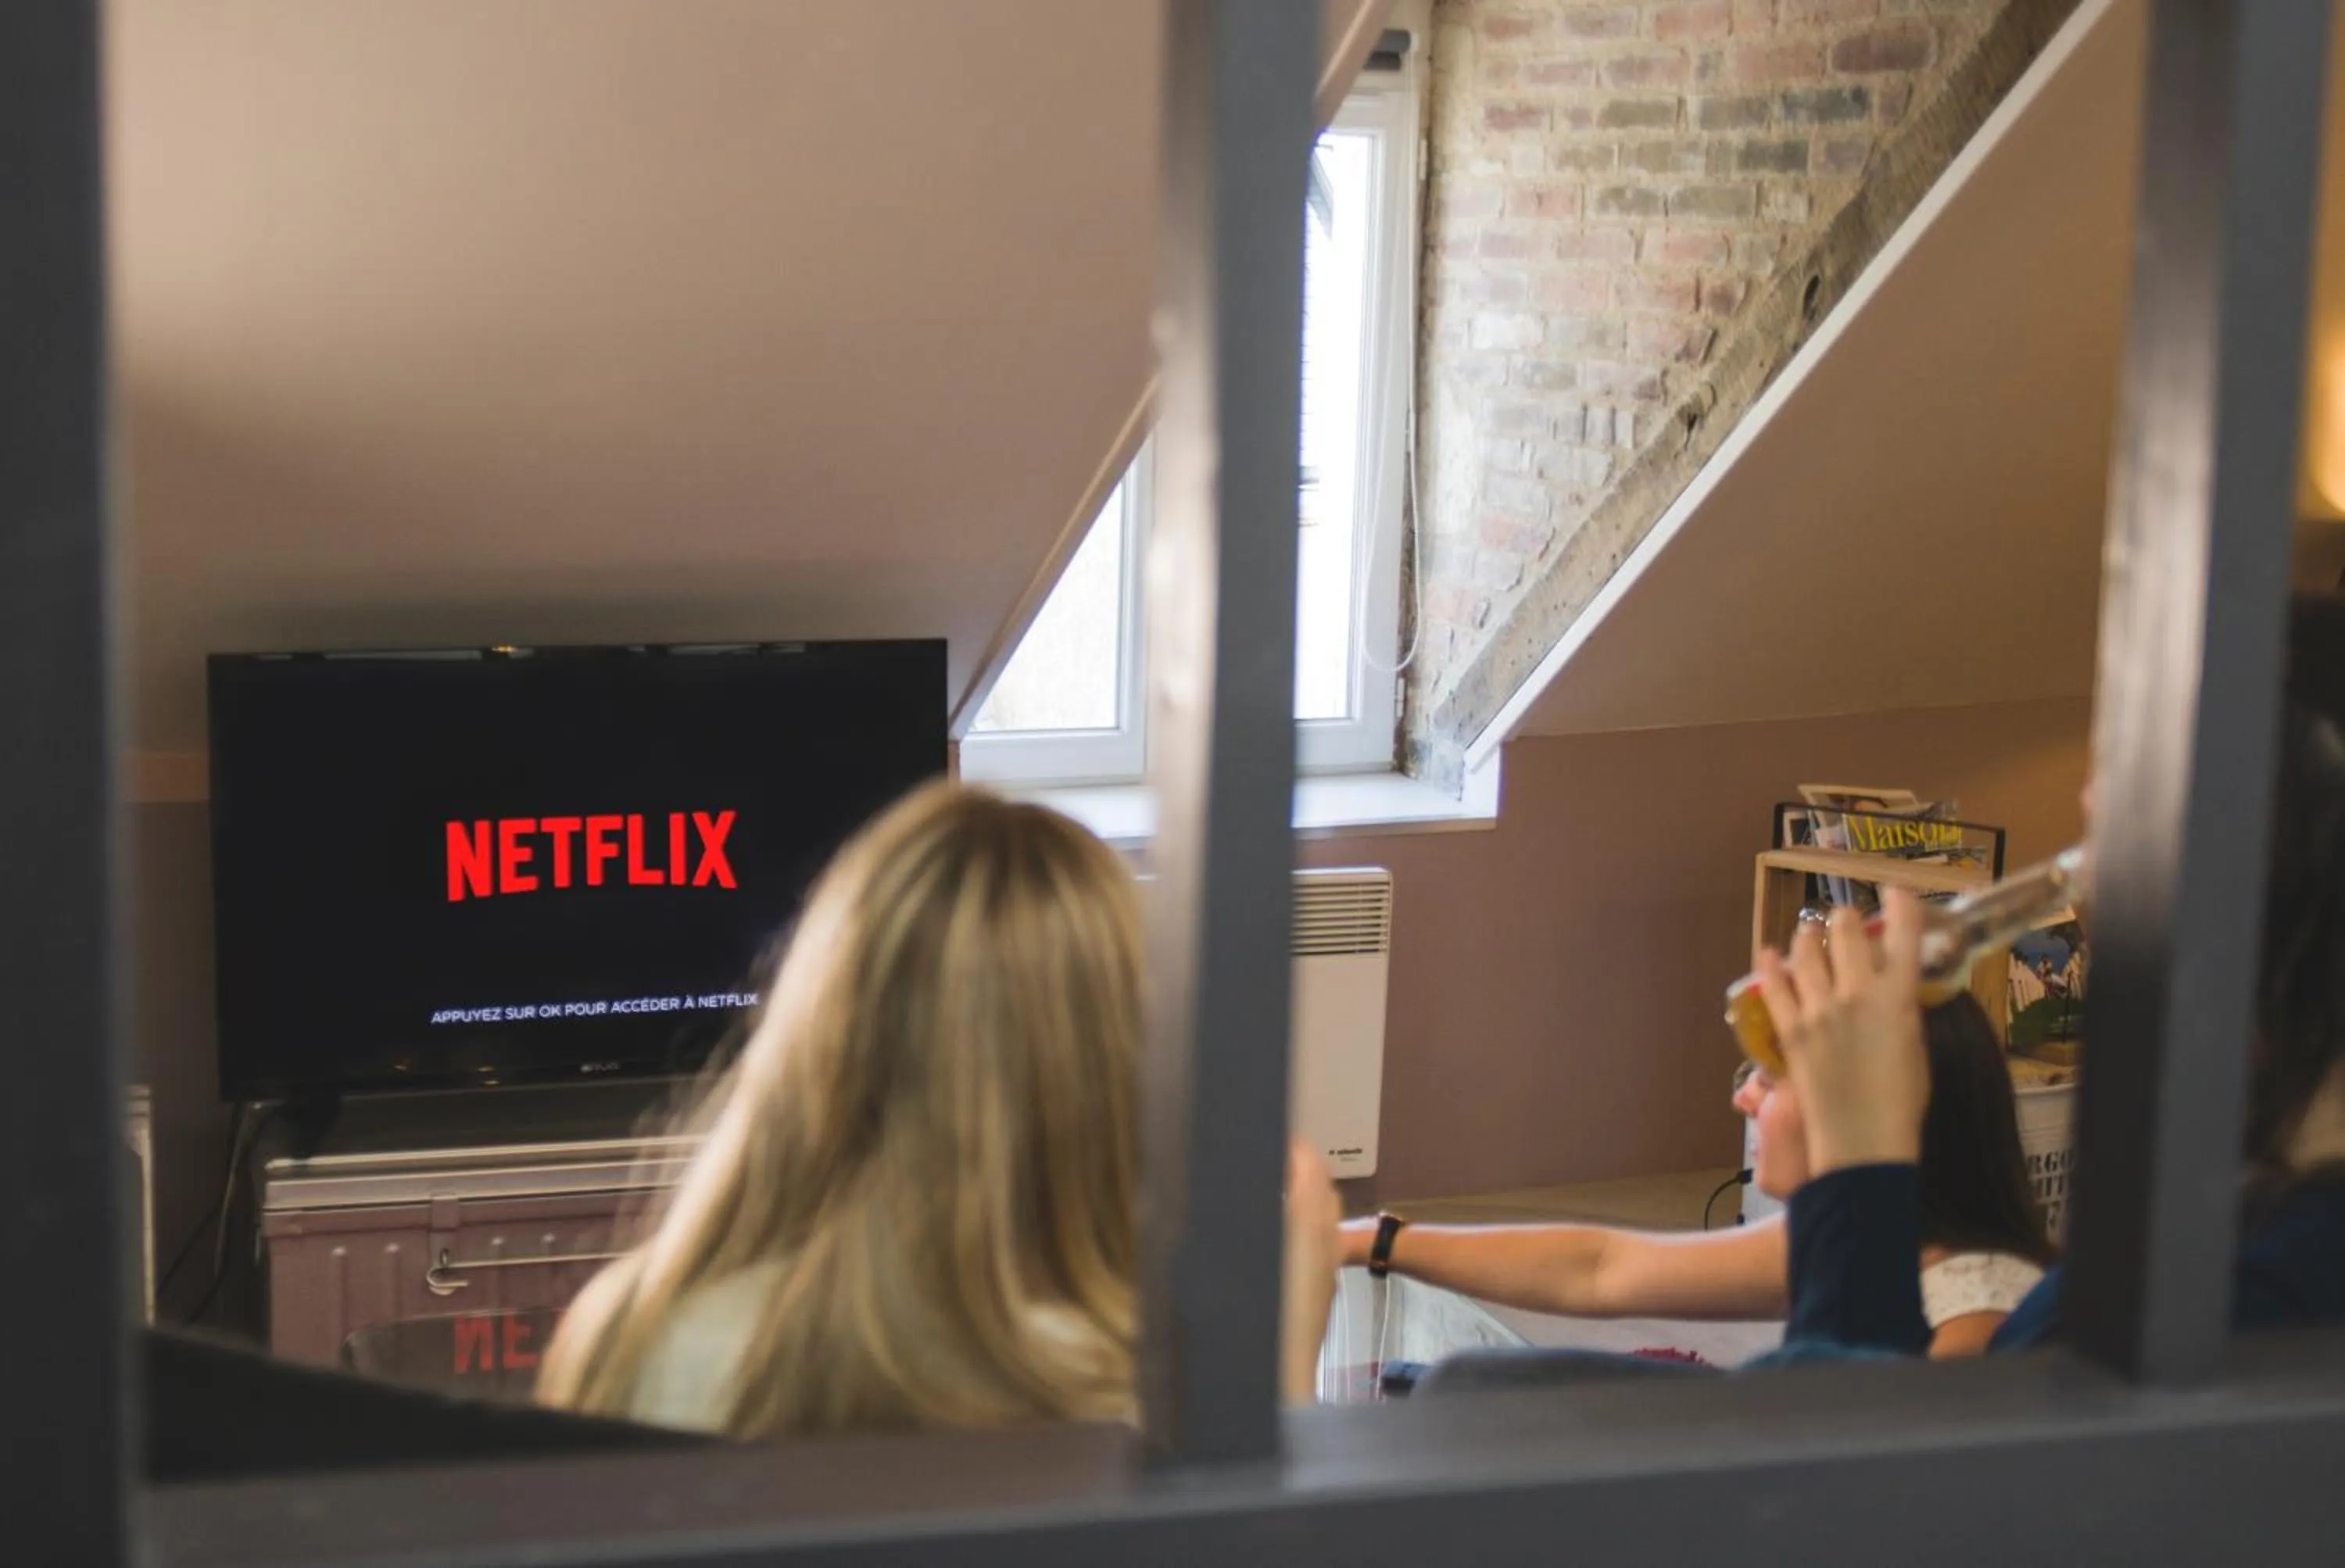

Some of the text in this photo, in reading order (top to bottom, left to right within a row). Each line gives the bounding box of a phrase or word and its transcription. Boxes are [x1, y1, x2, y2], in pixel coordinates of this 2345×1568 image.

[1846, 814, 1961, 852] Maison
[446, 810, 737, 902] NETFLIX
[431, 993, 758, 1023] APPUYEZ SUR OK POUR ACCÉDER À NETFLIX
